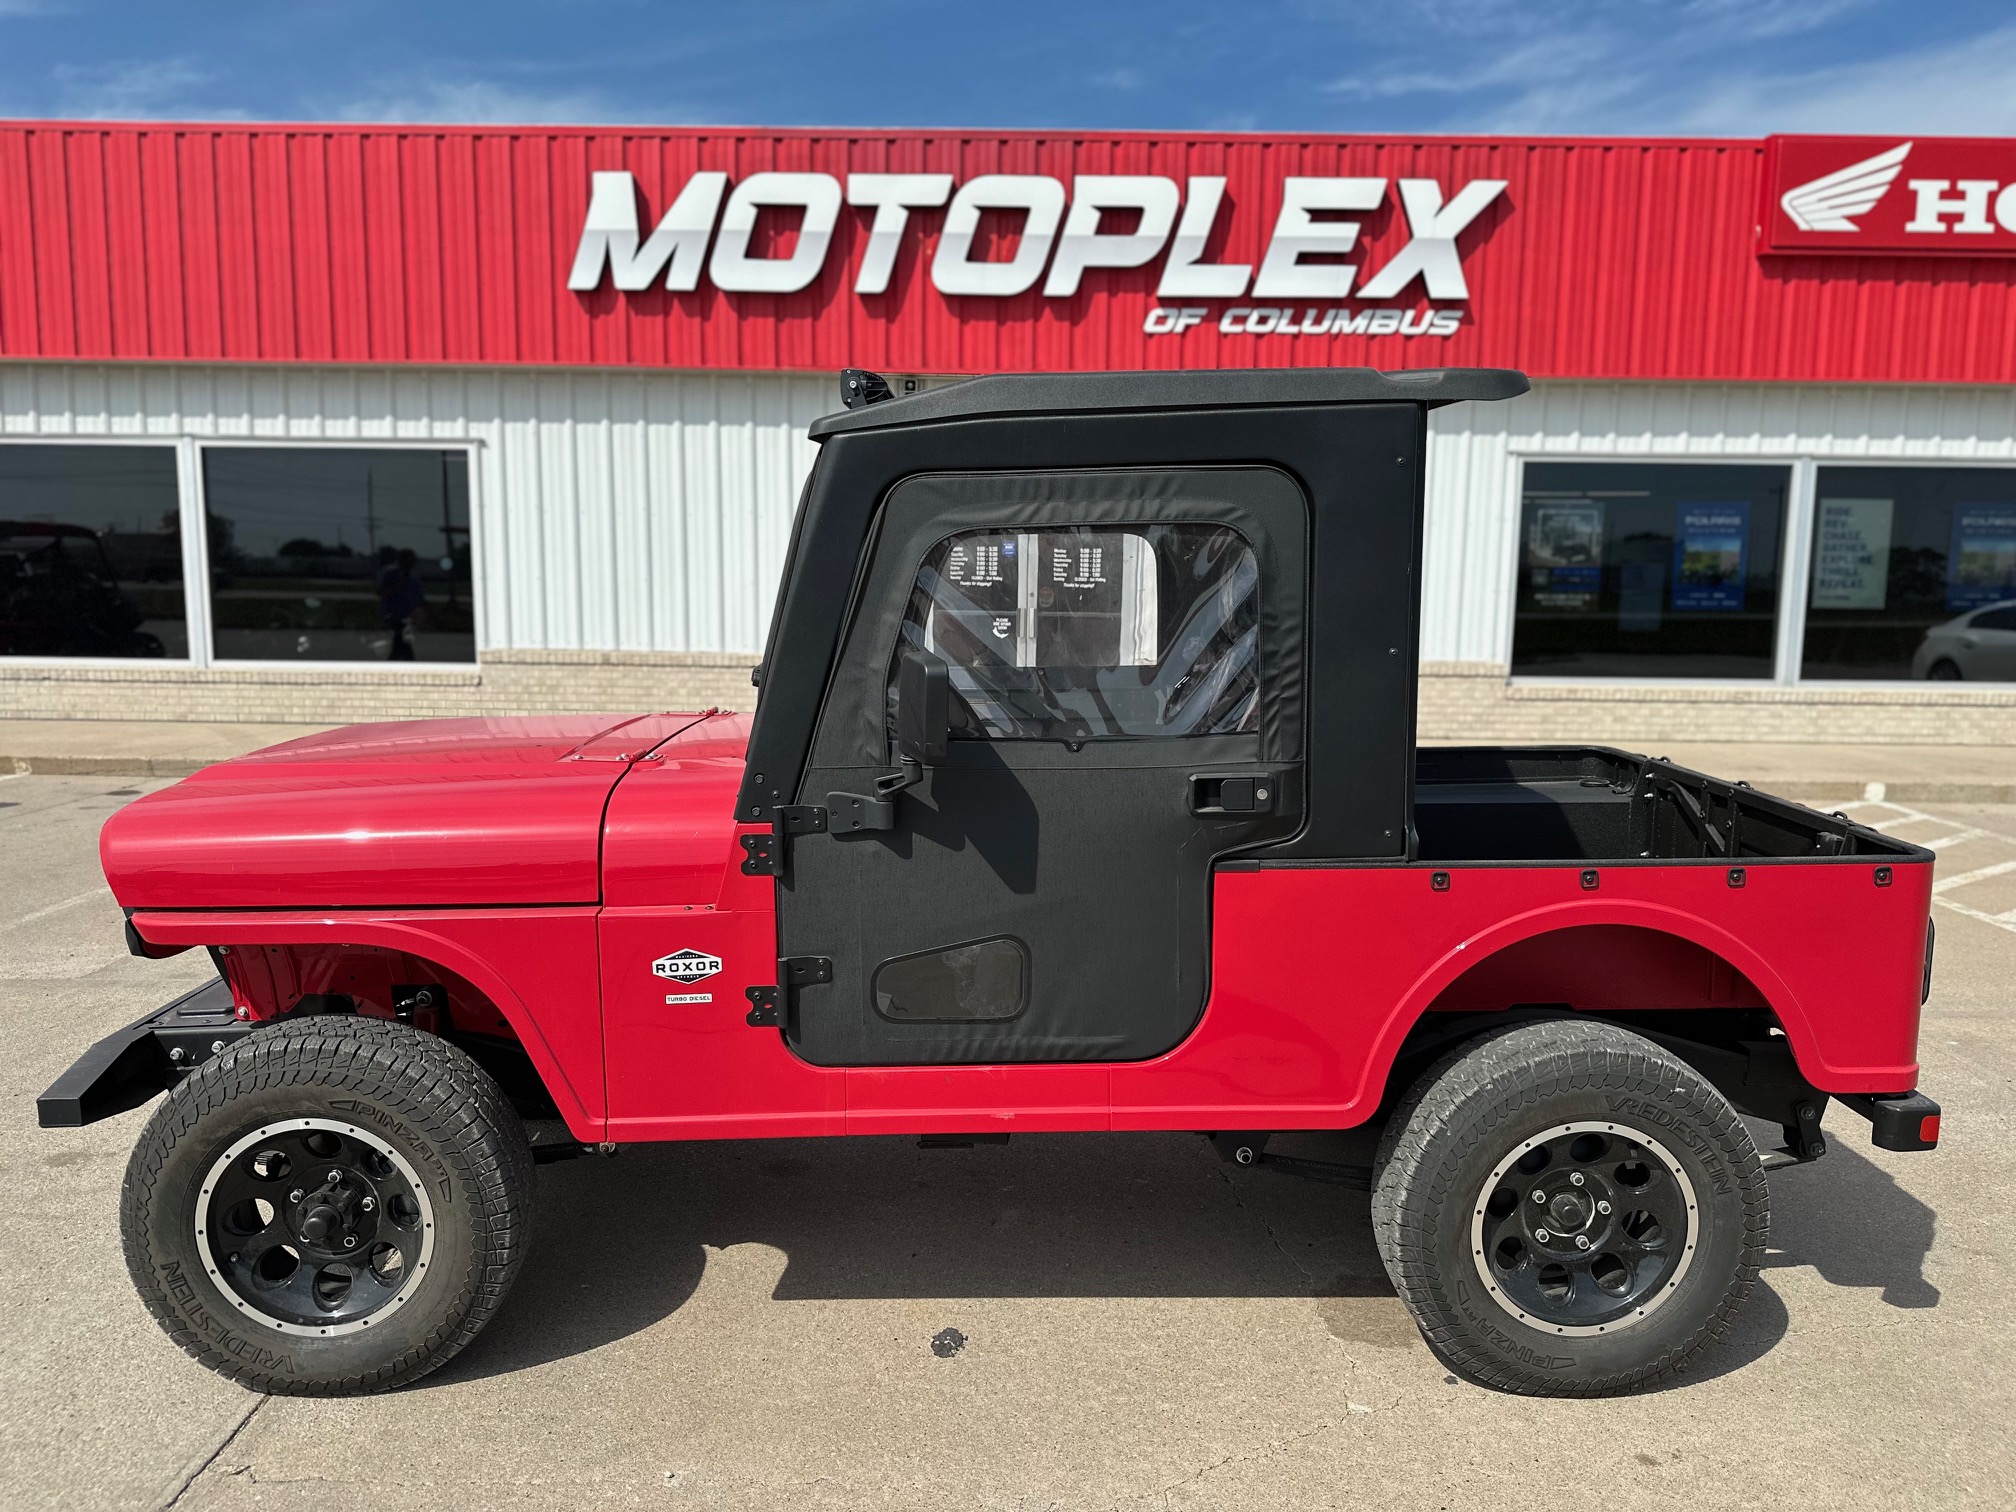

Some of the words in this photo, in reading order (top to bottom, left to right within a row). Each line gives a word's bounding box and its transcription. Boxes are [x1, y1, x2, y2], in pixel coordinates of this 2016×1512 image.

[567, 171, 1509, 300] MOTOPLEX
[1143, 307, 1207, 333] OF
[1218, 308, 1464, 335] COLUMBUS
[656, 961, 719, 973] ROXOR
[354, 1101, 435, 1161] PINZA
[1603, 1094, 1732, 1195] VREDESTEIN
[161, 1259, 295, 1375] VREDESTEIN
[1475, 1317, 1552, 1370] PINZA
